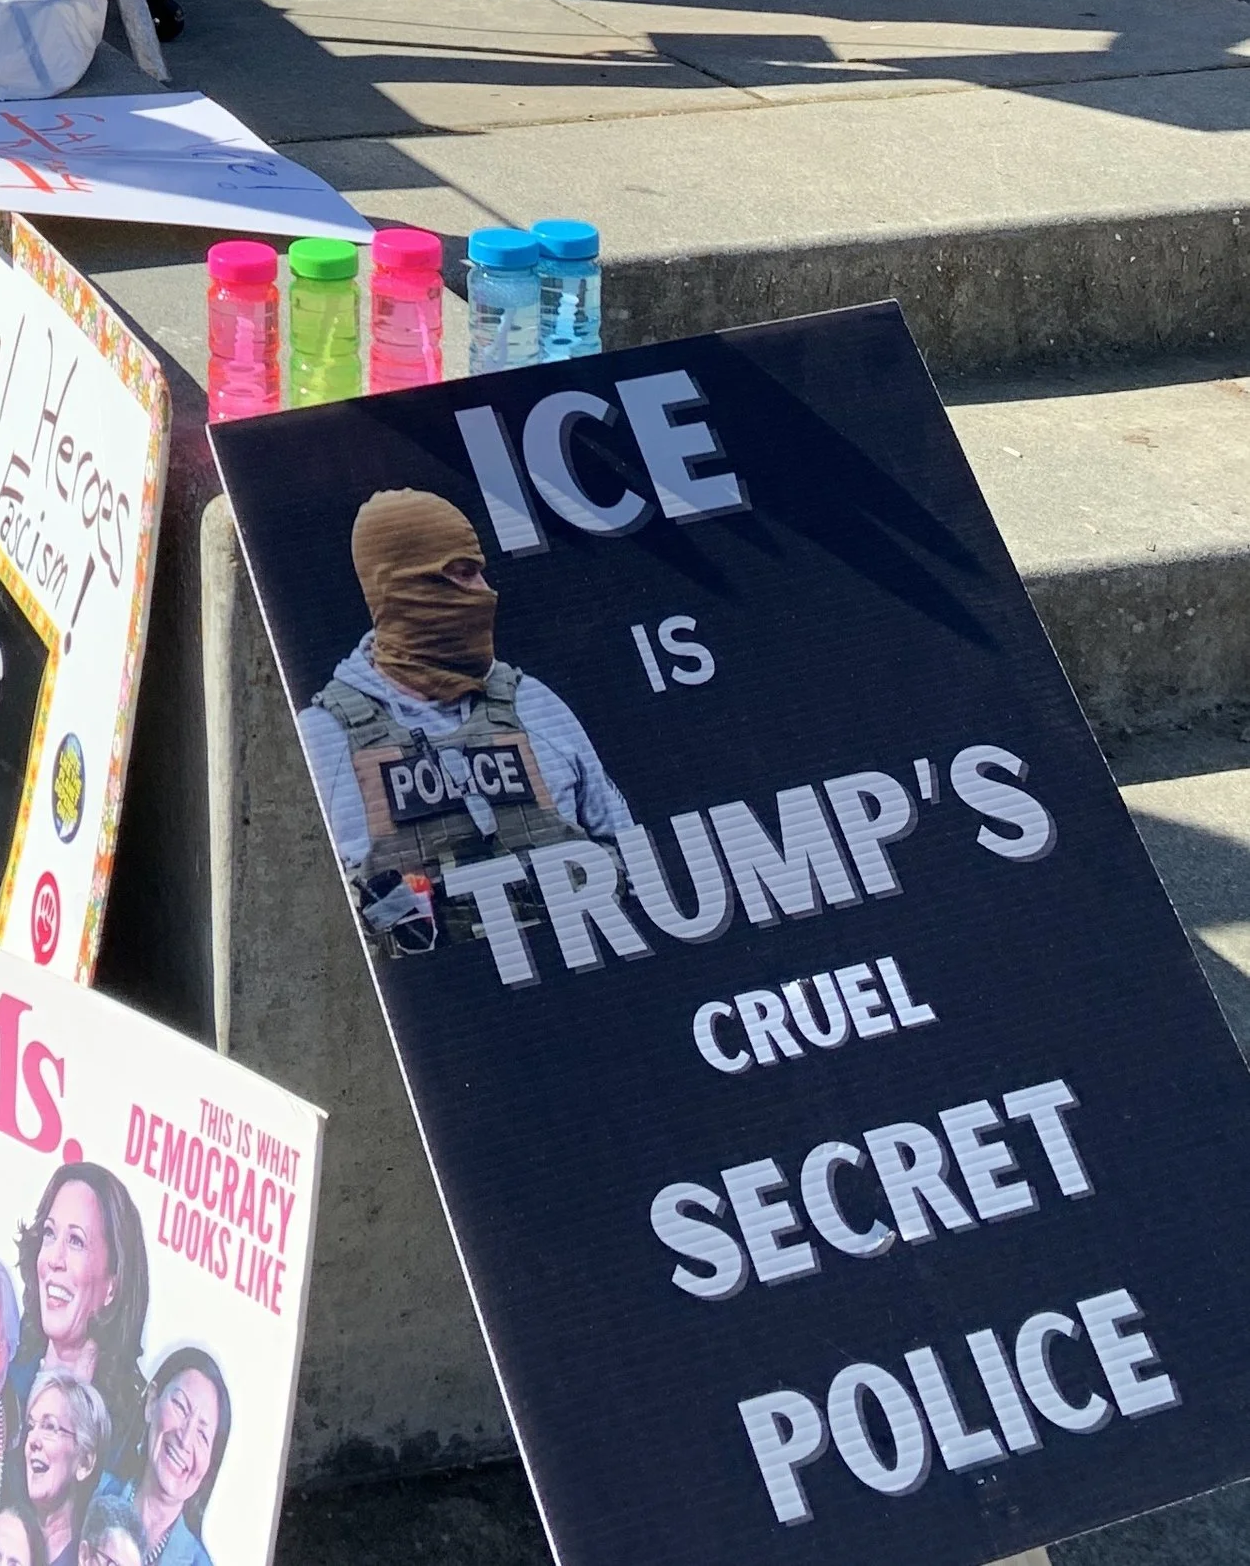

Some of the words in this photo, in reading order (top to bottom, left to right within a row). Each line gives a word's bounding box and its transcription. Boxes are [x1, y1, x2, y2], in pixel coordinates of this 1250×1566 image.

[31, 327, 130, 588] Heroes
[454, 369, 750, 556] ICE
[630, 614, 716, 694] IS
[441, 744, 1057, 986] TRUMP'S
[692, 956, 938, 1074] CRUEL
[124, 1103, 296, 1255] DEMOCRACY
[200, 1097, 234, 1148] THIS
[236, 1119, 252, 1159] IS
[257, 1128, 301, 1187] WHAT
[650, 1079, 1094, 1300] SECRET
[157, 1191, 232, 1280] LOOKS
[234, 1236, 287, 1316] LIKE
[737, 1288, 1180, 1525] POLICE
